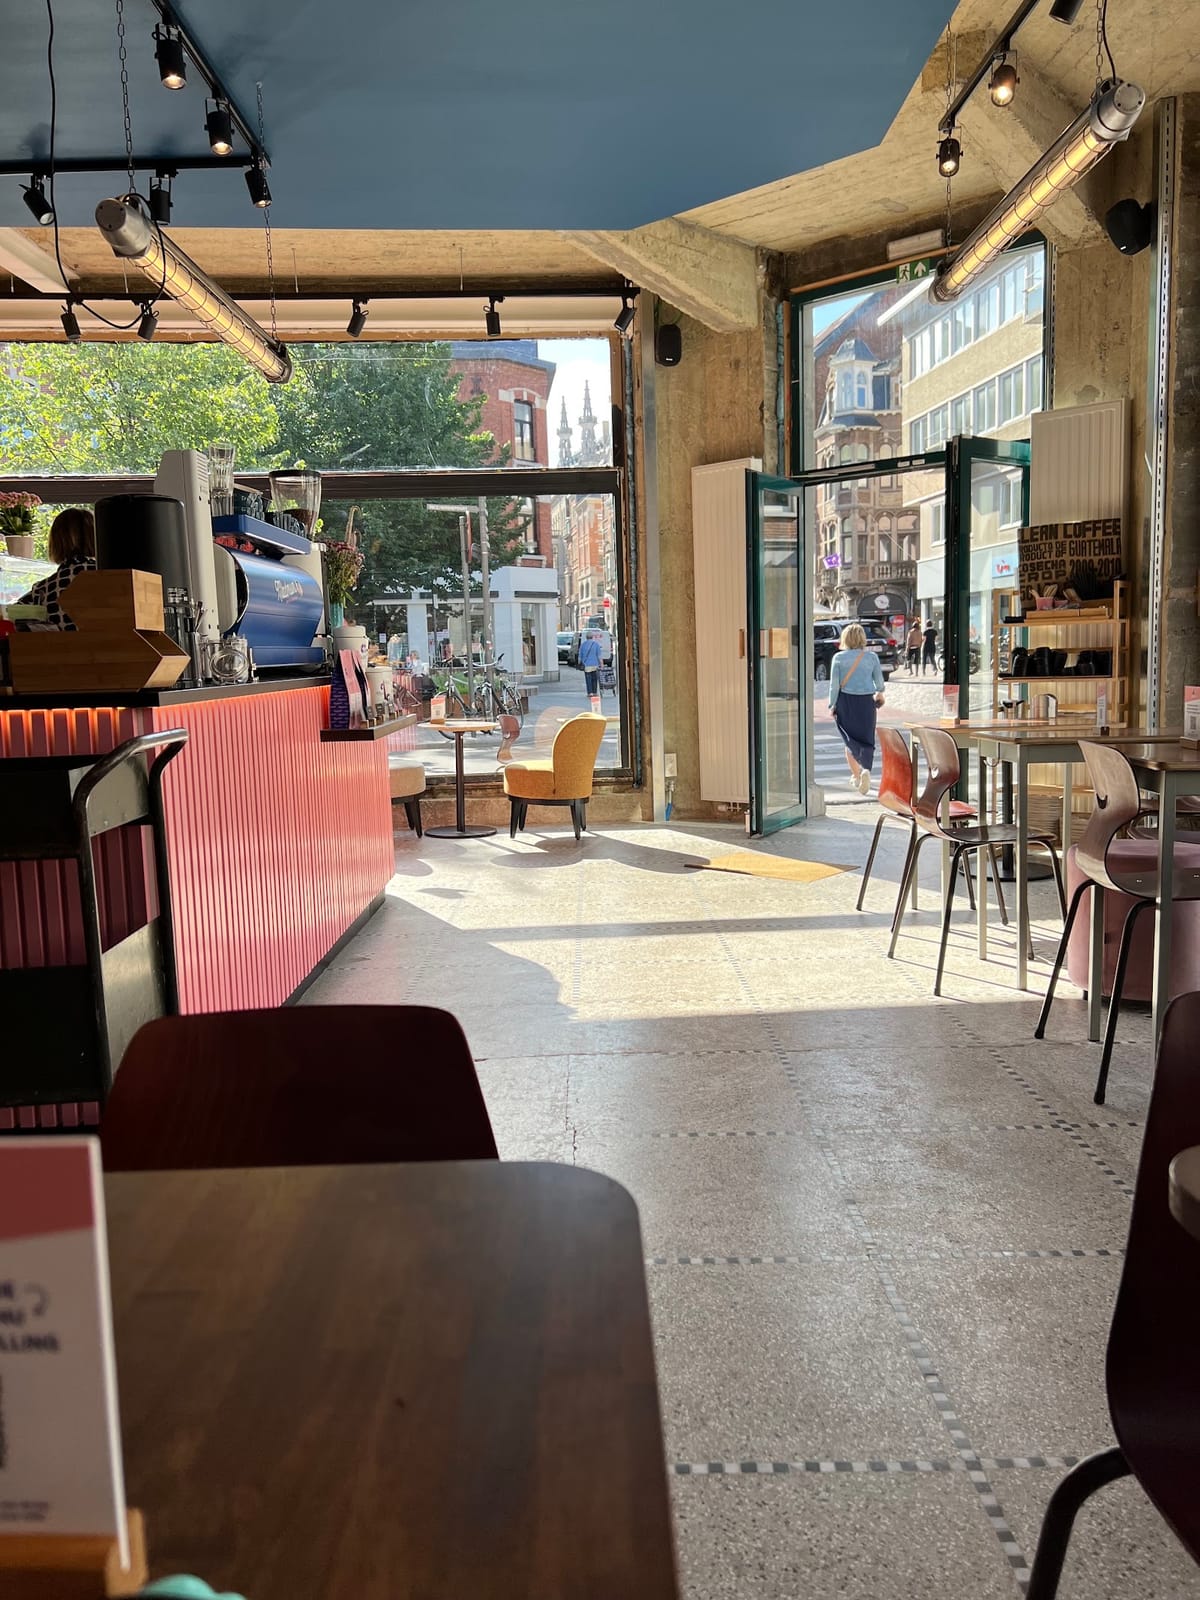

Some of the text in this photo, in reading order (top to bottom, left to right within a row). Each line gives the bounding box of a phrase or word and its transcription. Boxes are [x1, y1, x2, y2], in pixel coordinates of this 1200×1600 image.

[1018, 524, 1058, 543] LEAN
[1021, 542, 1053, 553] ODUCTO
[1020, 559, 1066, 573] OSECHA
